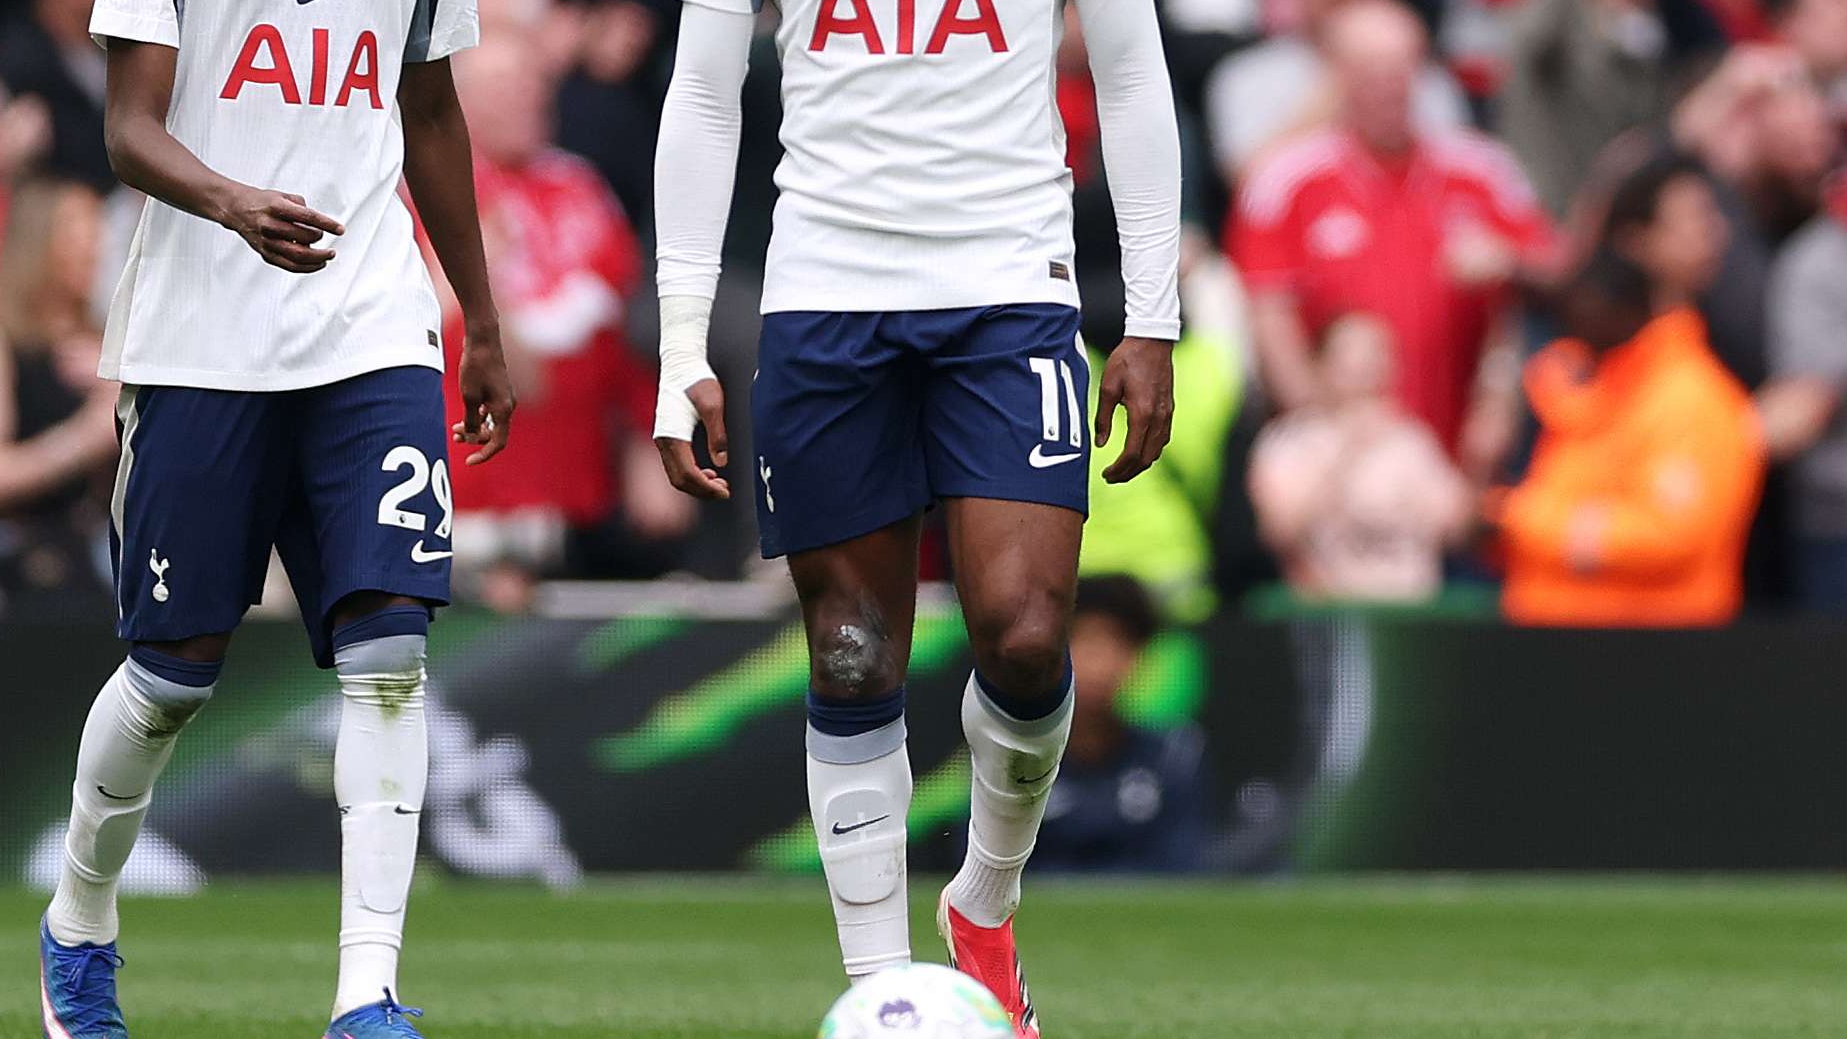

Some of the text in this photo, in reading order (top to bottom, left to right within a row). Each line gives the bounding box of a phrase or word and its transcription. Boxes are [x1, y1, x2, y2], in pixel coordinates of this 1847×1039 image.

[218, 23, 384, 109] AIA
[1029, 357, 1081, 448] 11
[378, 445, 453, 539] 29
